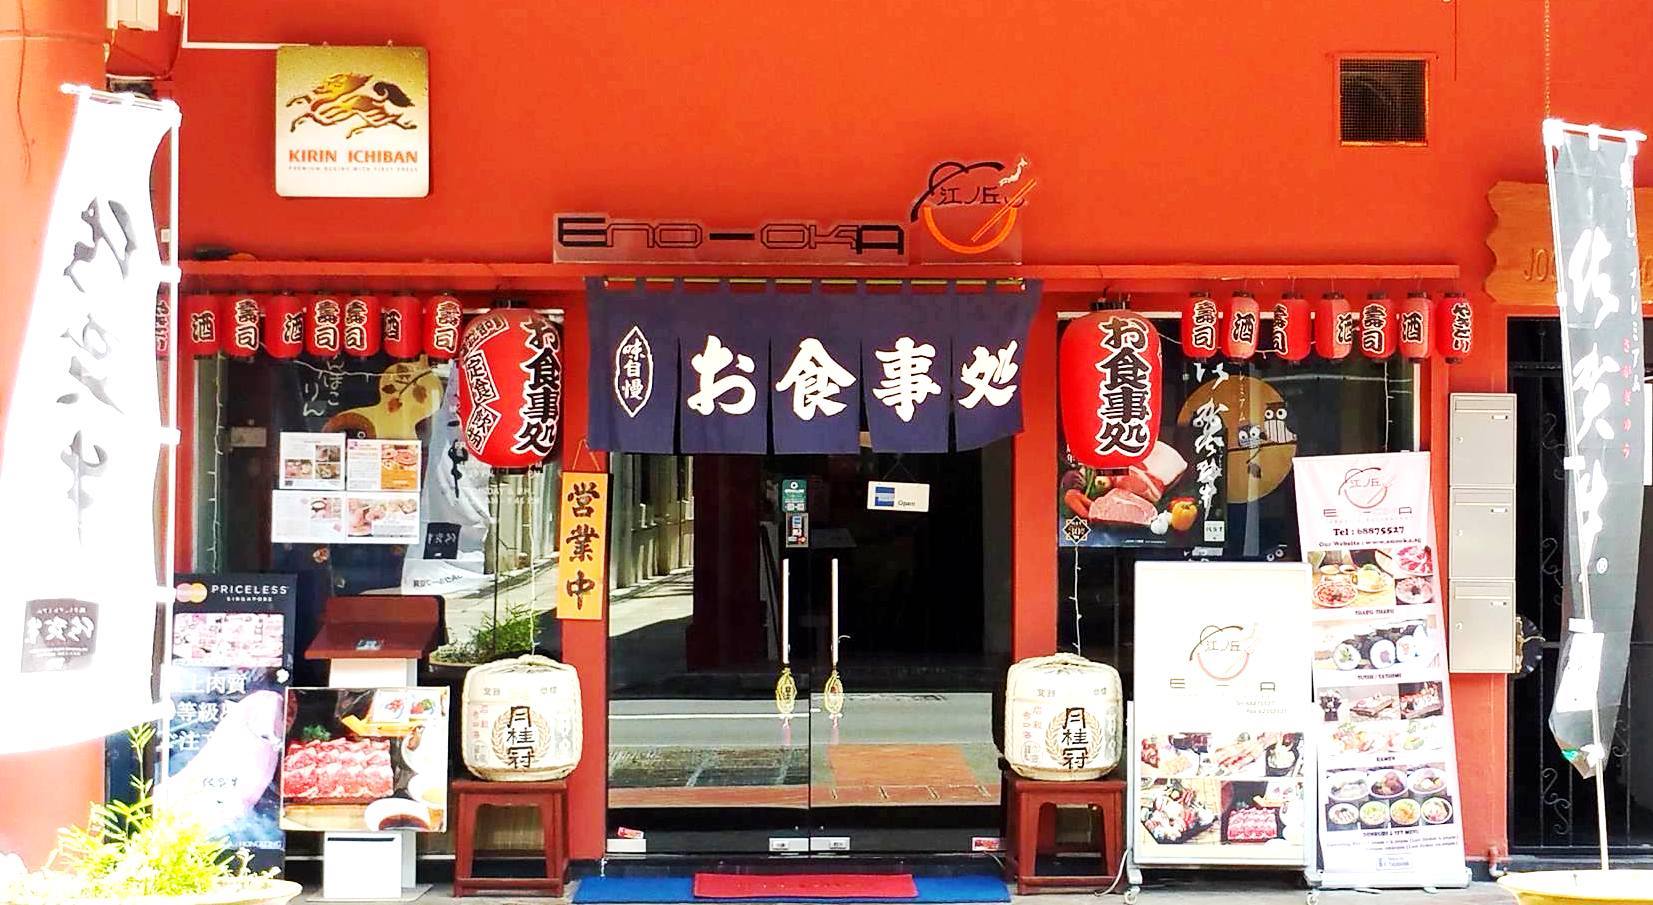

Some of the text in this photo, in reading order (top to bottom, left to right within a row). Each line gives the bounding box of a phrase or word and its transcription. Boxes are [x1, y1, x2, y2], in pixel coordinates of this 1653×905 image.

[289, 150, 418, 163] KIRIN ICHIBAN
[192, 311, 216, 342] 酒
[283, 312, 303, 343] 酒
[383, 310, 401, 340] 酒
[1231, 312, 1256, 345] 酒
[1401, 311, 1424, 343] 酒
[1452, 303, 1472, 352] やきとり
[511, 317, 562, 456] お食事処
[622, 339, 645, 401] 味自慢
[687, 335, 1019, 422] お食事処
[1095, 316, 1150, 456] お食事処
[1333, 528, 1349, 536] Tel
[211, 584, 288, 595] PRICELESS
[507, 705, 535, 769] 月桂冠
[1062, 707, 1089, 769] 月桂冠
